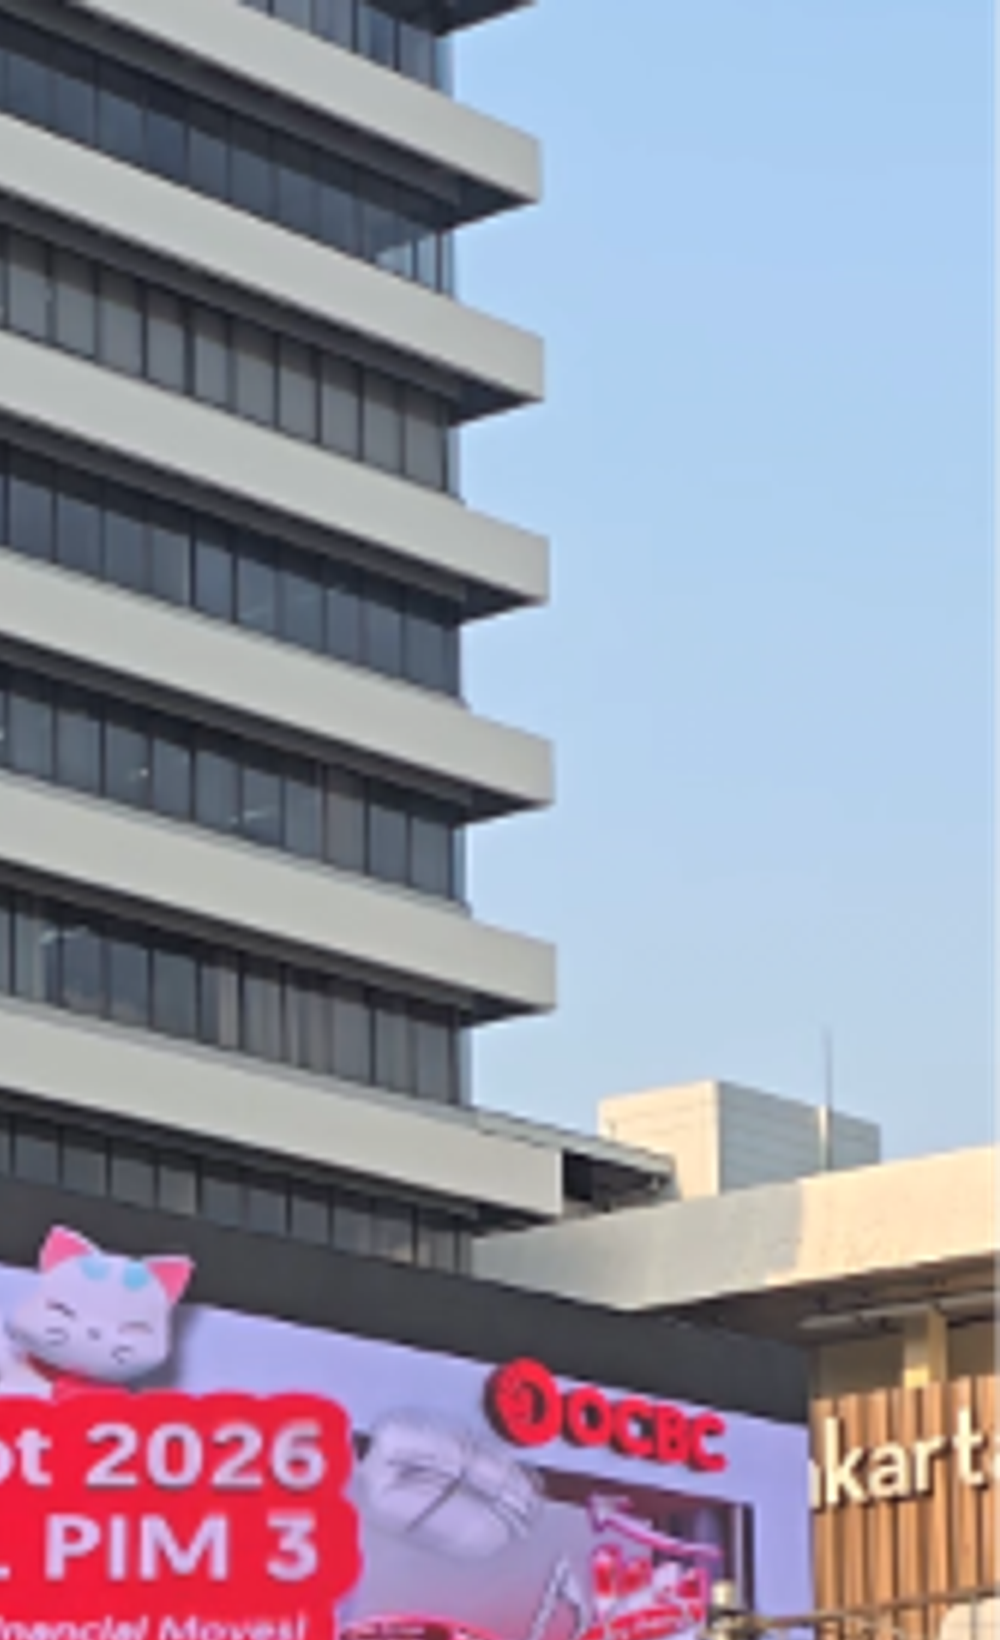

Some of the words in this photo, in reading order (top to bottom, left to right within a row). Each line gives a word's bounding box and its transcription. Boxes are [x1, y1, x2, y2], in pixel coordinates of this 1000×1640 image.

[84, 1421, 327, 1490] 2026
[562, 1383, 729, 1474] OCBC
[808, 1406, 1000, 1510] kart
[44, 1513, 230, 1582] PIM
[266, 1514, 319, 1582] 3
